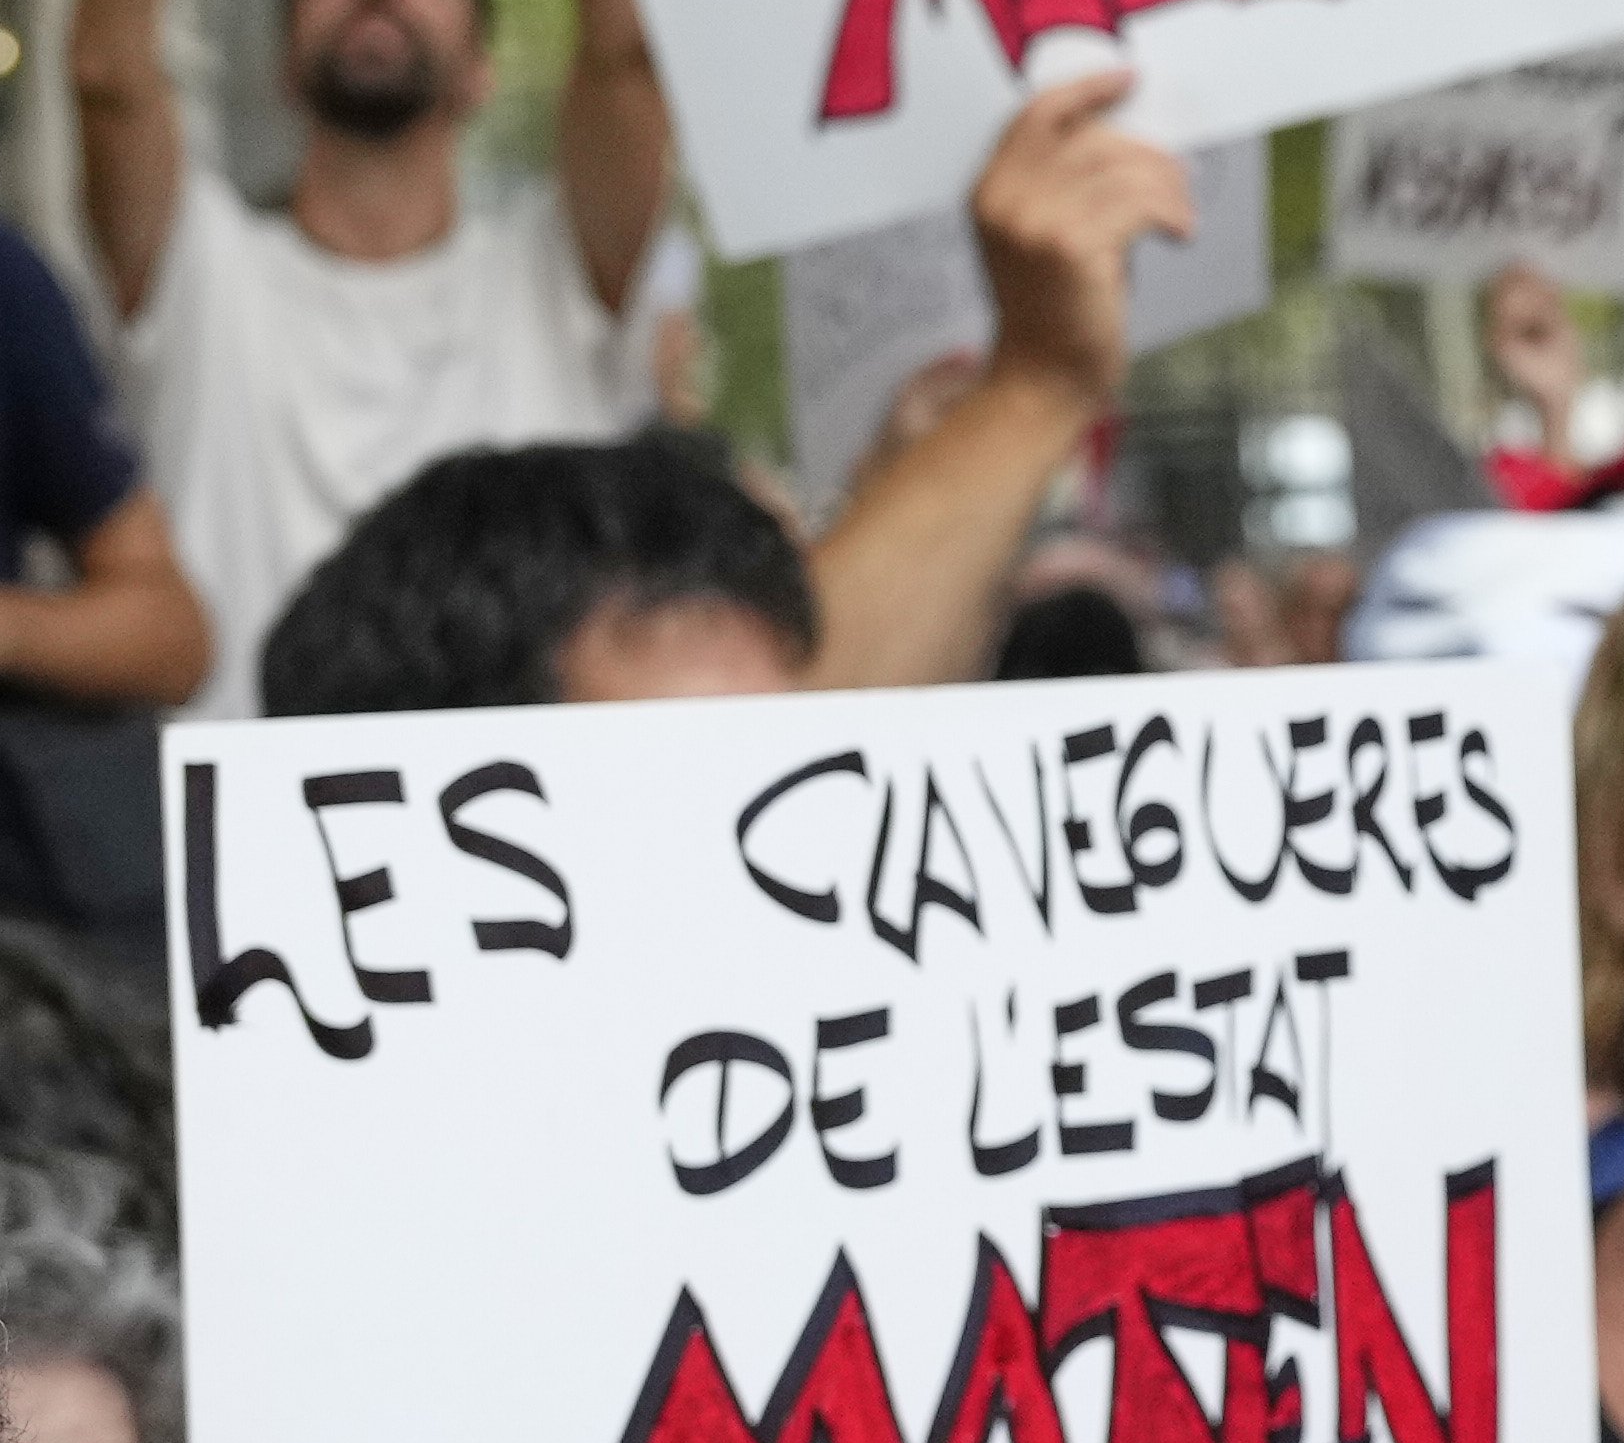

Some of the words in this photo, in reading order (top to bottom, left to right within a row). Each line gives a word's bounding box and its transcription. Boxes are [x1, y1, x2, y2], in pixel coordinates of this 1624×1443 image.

[182, 760, 575, 1060] LES
[735, 710, 1519, 965] CLAVEGUERES
[659, 1005, 898, 1196] DE
[965, 948, 1350, 1176] L'ESTAT
